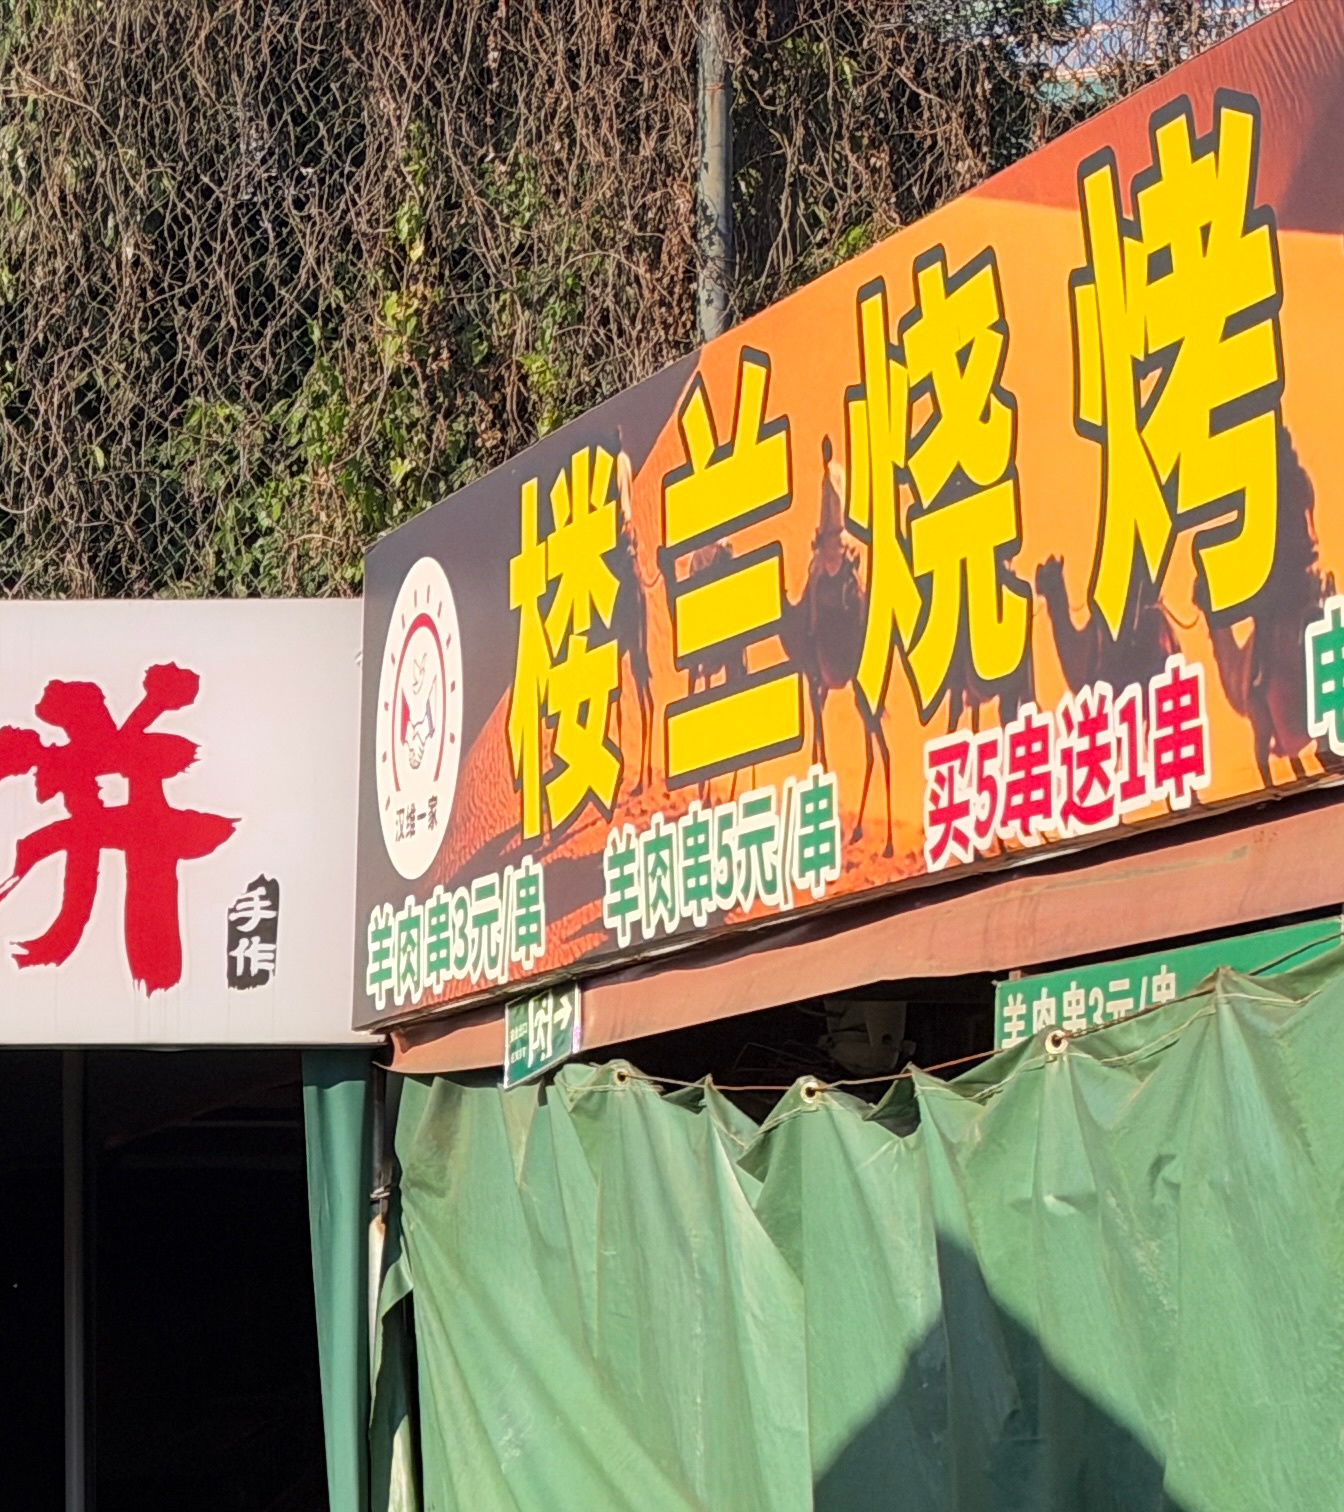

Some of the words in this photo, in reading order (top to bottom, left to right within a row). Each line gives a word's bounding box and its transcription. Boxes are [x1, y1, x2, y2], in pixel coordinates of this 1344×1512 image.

[507, 89, 1283, 840] 楼兰烧烤
[395, 794, 438, 842] 汉维一家
[925, 655, 1212, 871] 买5串送1串
[229, 887, 276, 978] 手作
[366, 855, 546, 1010] 羊肉串3元/串
[603, 763, 840, 946] 羊肉串5元/串
